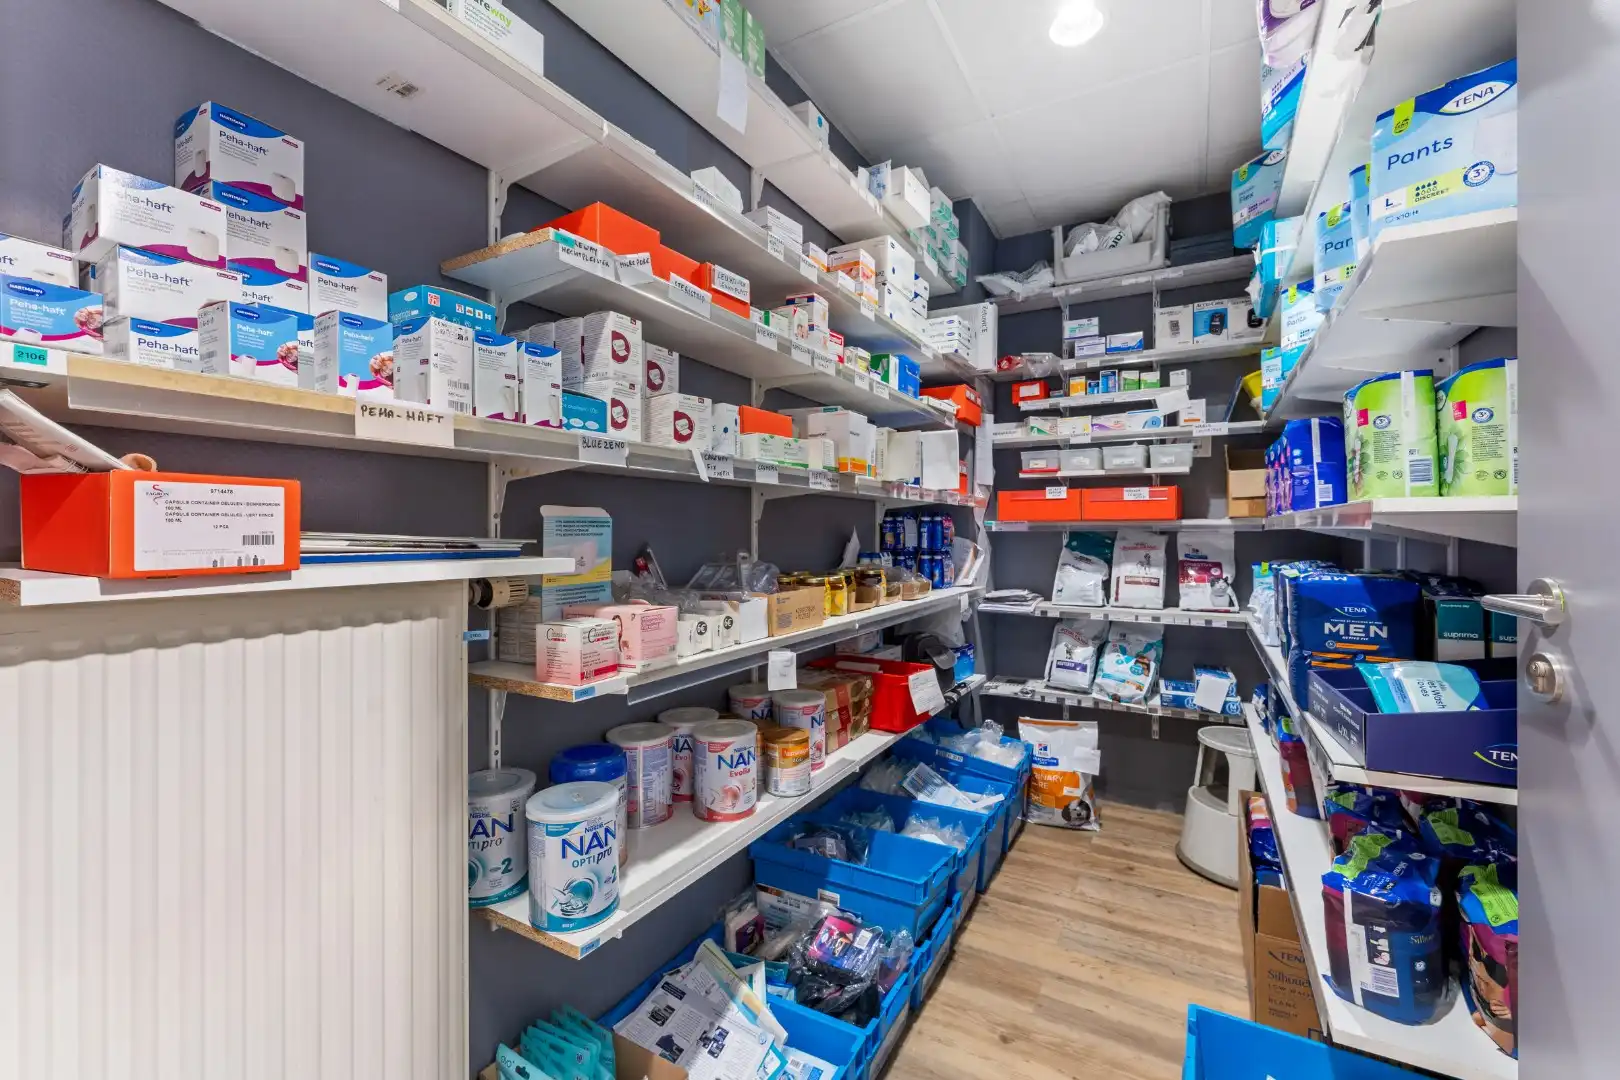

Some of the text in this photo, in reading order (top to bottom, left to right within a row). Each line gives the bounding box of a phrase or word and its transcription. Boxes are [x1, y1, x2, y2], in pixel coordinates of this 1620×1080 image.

[1453, 86, 1491, 109] TENA
[220, 113, 246, 127] HARTMANN
[219, 130, 266, 155] Peha-haft
[1387, 137, 1453, 170] Pants
[1386, 199, 1394, 207] L
[127, 265, 190, 290] Peha-haft
[318, 277, 357, 293] Peha-haft
[10, 284, 44, 295] HARTMANN
[10, 299, 66, 317] Peha-haft
[237, 324, 273, 337] Peha-haft
[17, 350, 45, 361] 2106
[138, 338, 198, 357] Peha-haft
[1343, 606, 1367, 614] TENA
[1324, 622, 1388, 639] MEN
[1444, 631, 1479, 639] suprima
[752, 708, 773, 721] NA
[673, 738, 694, 754] NA
[718, 747, 756, 771] NAN
[730, 768, 751, 778] Evolia
[468, 813, 513, 840] AN
[585, 821, 604, 834] Nestlé
[562, 821, 617, 859] NAN
[502, 858, 513, 874] 2
[1281, 952, 1305, 963] TEN
